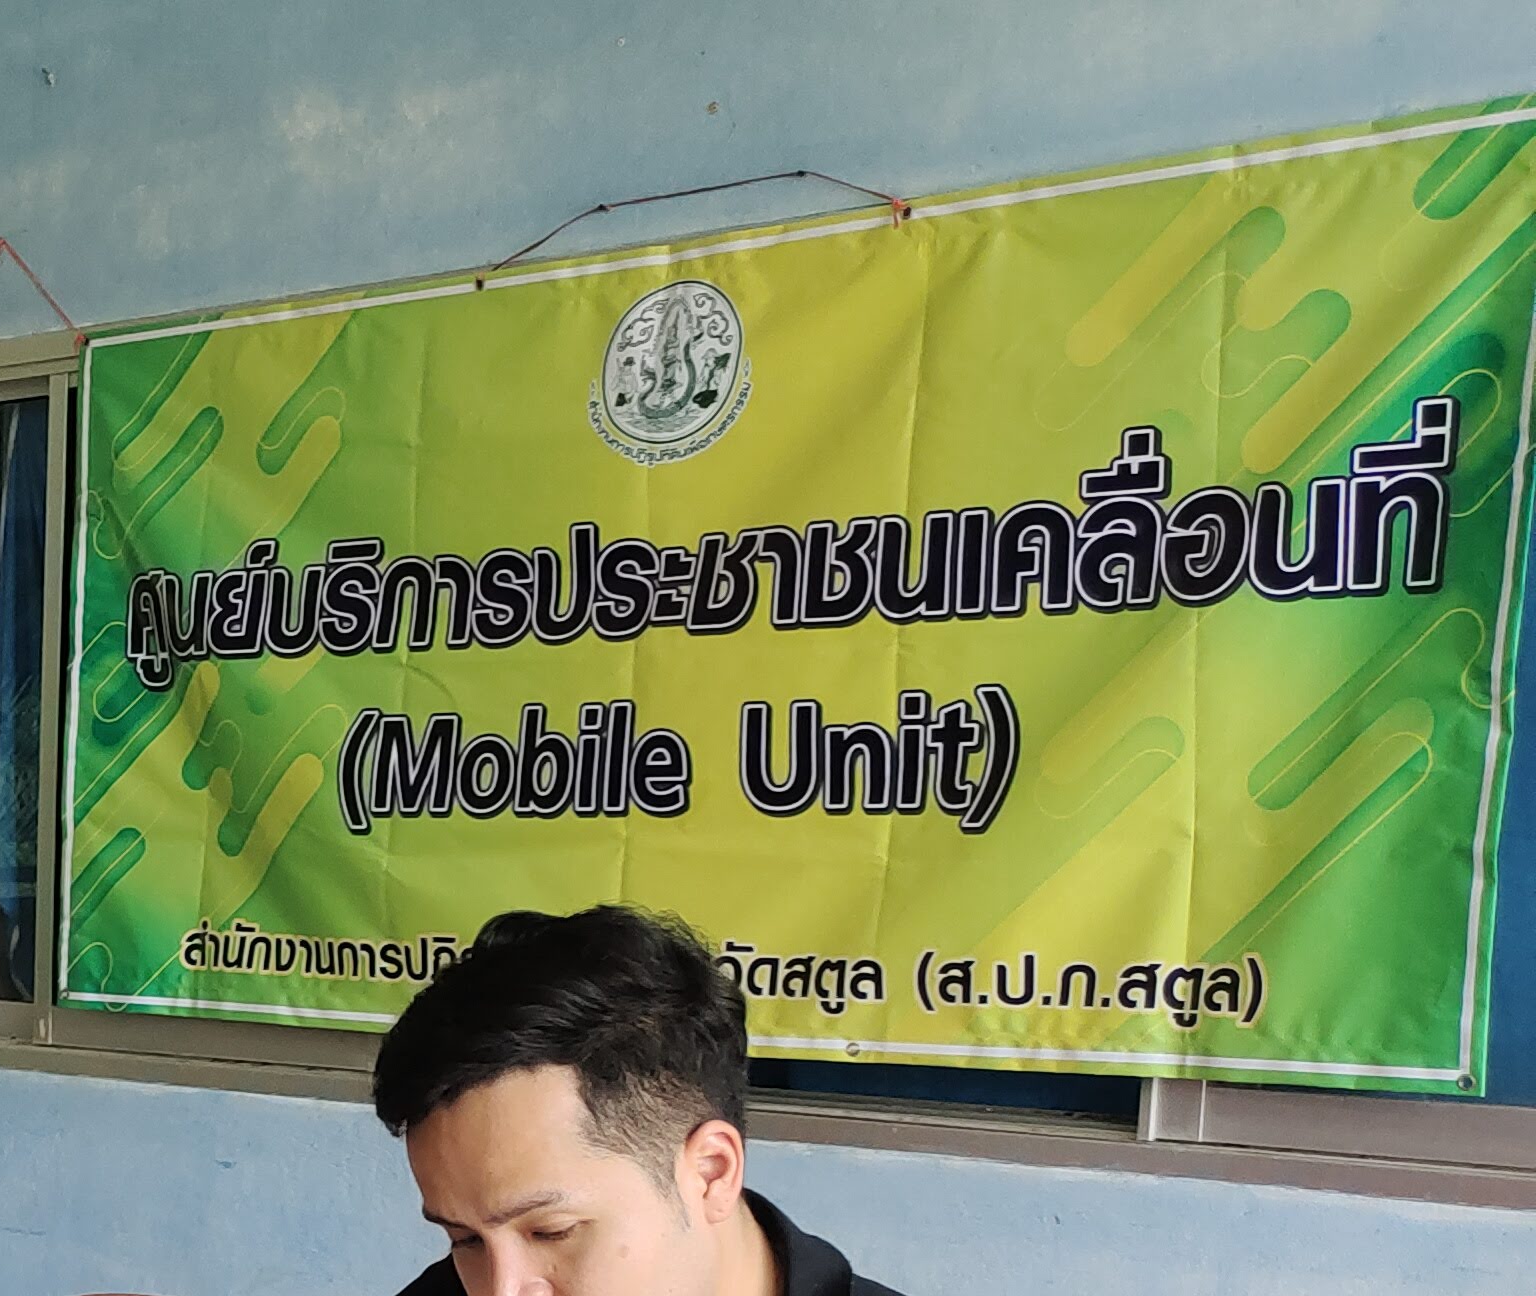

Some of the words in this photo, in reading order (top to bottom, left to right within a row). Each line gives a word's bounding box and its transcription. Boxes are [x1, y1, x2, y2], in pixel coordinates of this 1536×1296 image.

[127, 397, 1457, 690] ศูนย์บริการประชาชนเคลื่อนที่
[339, 705, 692, 833] (Mobile
[739, 685, 1021, 833] Unit)
[917, 951, 1263, 1027] (ส.ป.ก.สตูล)
